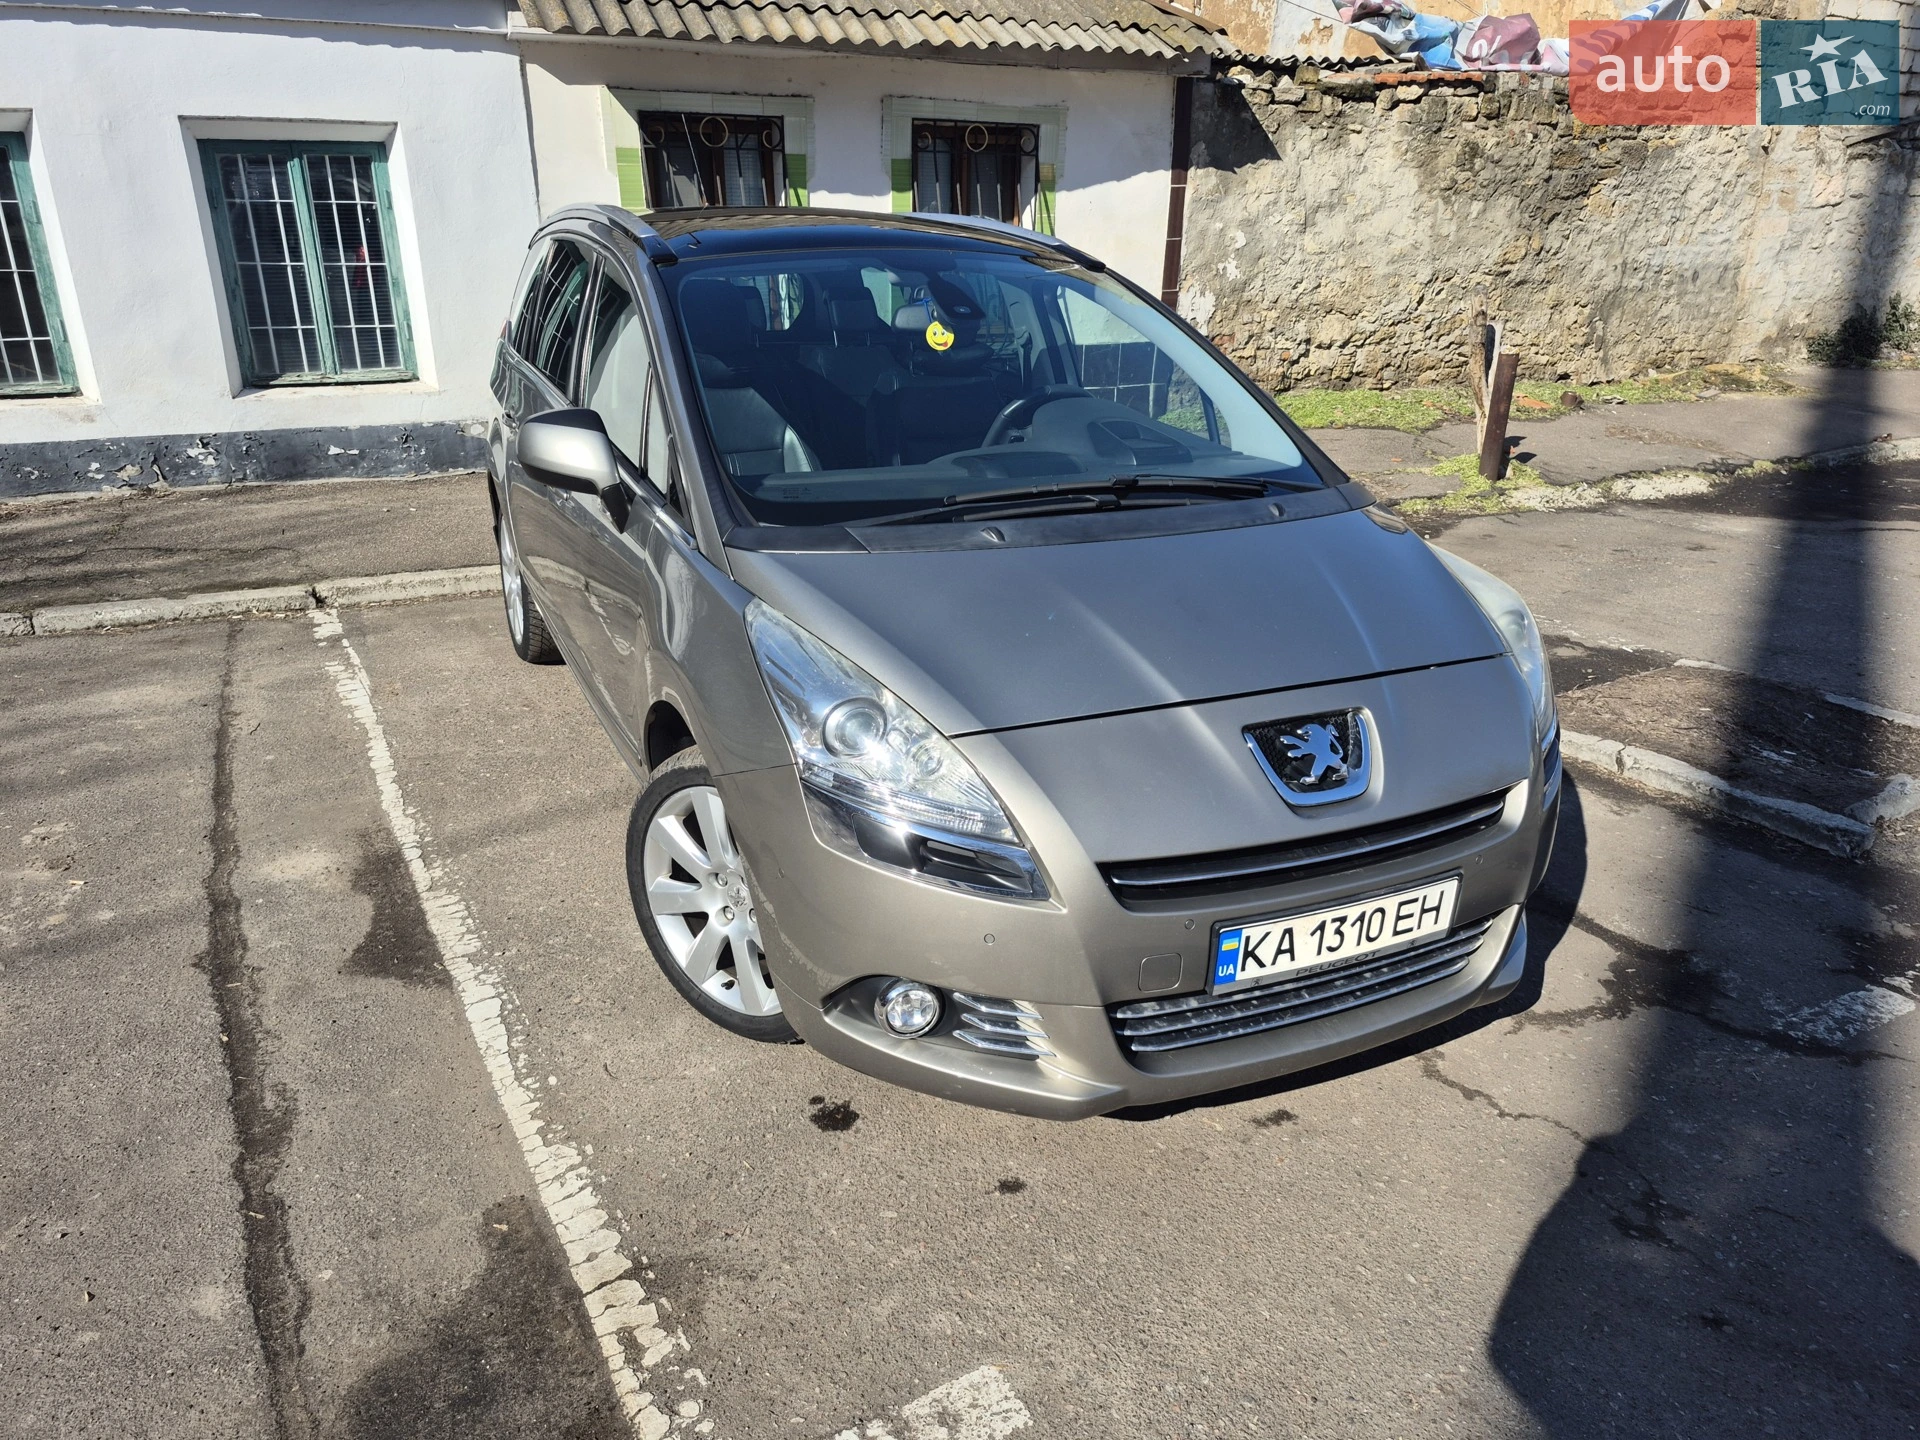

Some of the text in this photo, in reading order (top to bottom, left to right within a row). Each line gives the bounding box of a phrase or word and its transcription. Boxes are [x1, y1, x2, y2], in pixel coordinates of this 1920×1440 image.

[1240, 890, 1445, 972] KA 1310 EH
[1218, 963, 1235, 977] UA
[1295, 949, 1381, 977] PEUGEOT
